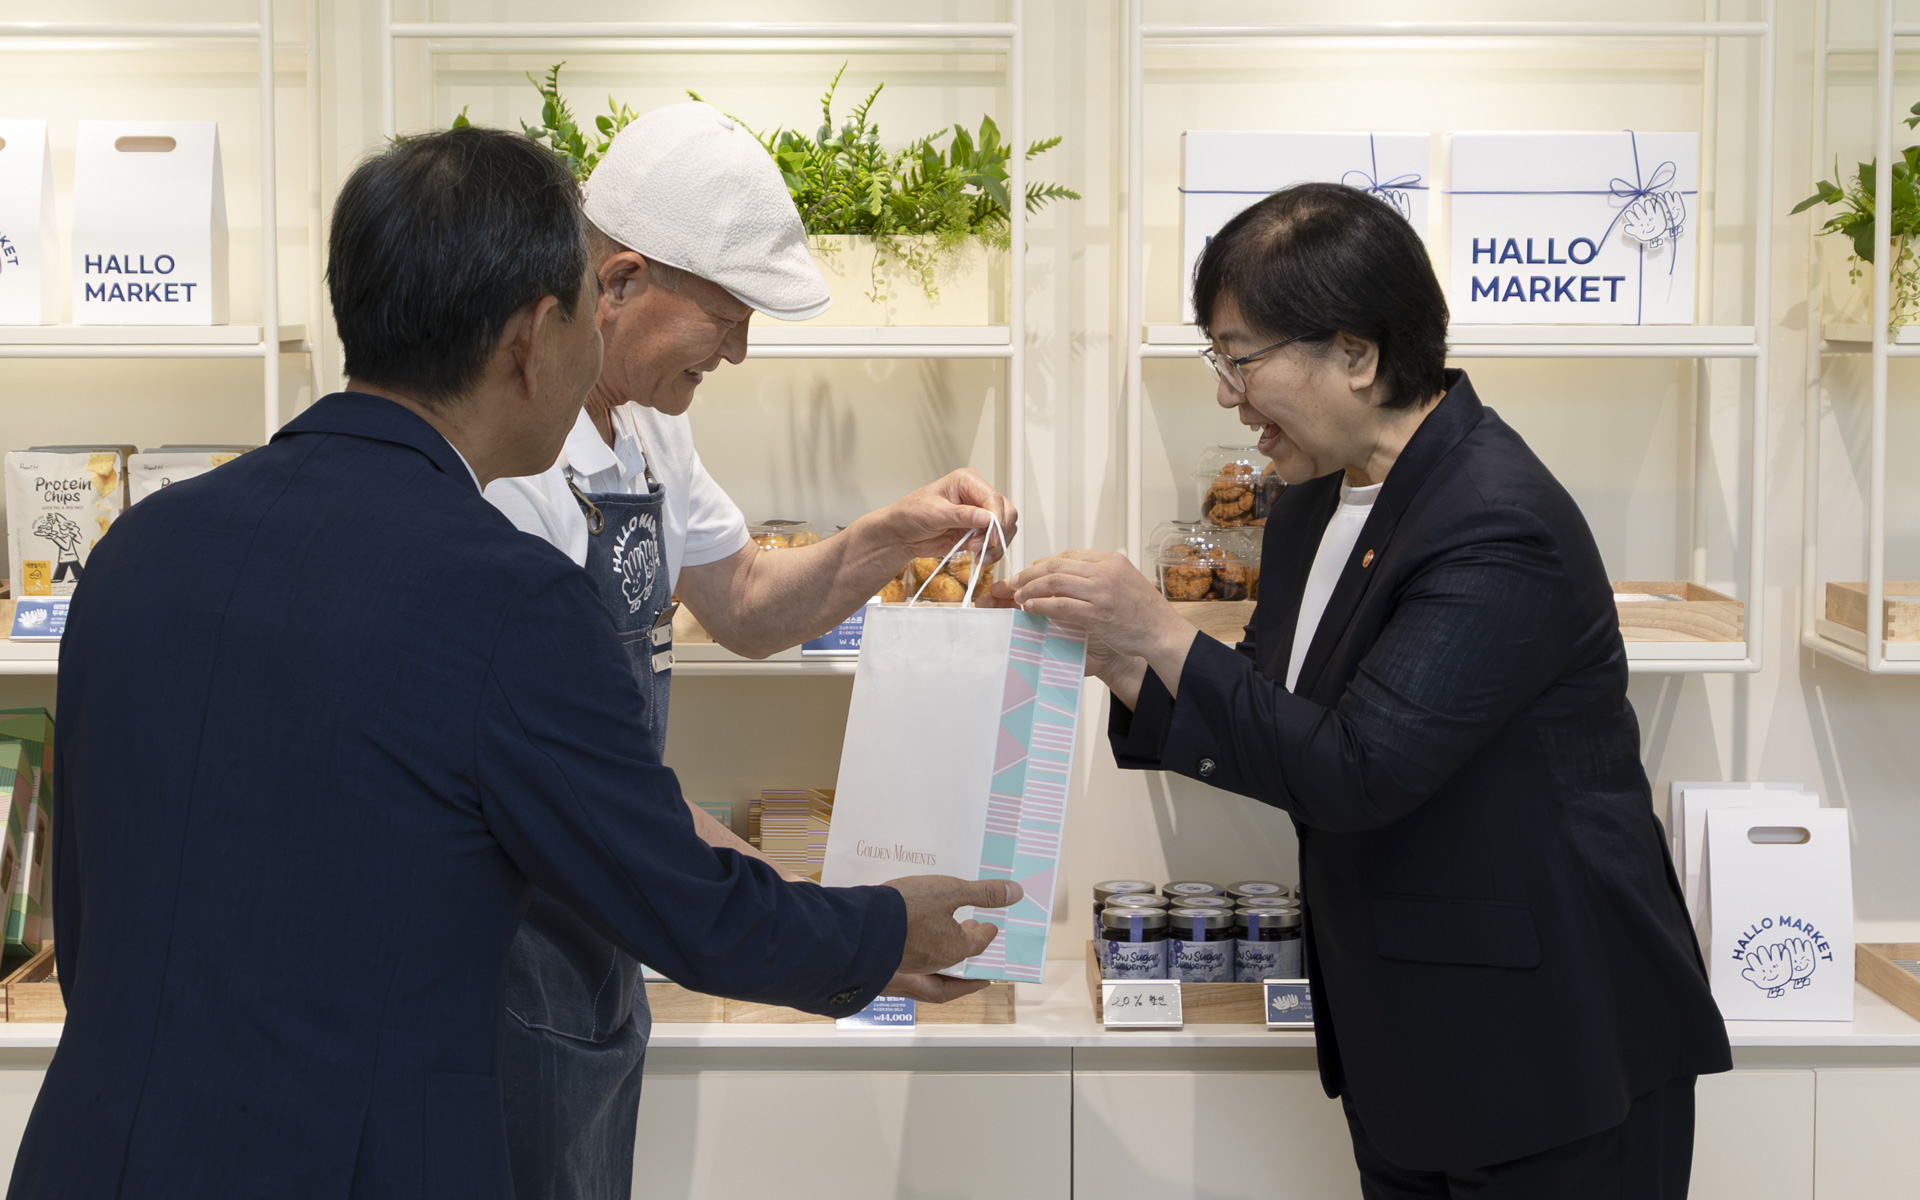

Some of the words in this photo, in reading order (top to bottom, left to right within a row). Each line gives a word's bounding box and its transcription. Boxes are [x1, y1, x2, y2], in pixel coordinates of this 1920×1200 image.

[0, 233, 19, 266] KET
[1472, 236, 1598, 265] HALLO
[84, 254, 176, 275] HALLO
[85, 282, 197, 302] MARKET
[1471, 275, 1627, 303] MARKET
[34, 476, 92, 492] Protein
[44, 490, 81, 505] Chips
[612, 516, 638, 574] HALLO
[856, 839, 891, 861] GOLDEN
[892, 843, 937, 866] MOMENTS
[1731, 916, 1774, 961] HALLO
[1778, 915, 1834, 962] MARKET
[1130, 951, 1159, 964] Sugar
[1193, 950, 1223, 963] Sugar
[1244, 949, 1275, 963] Sugar
